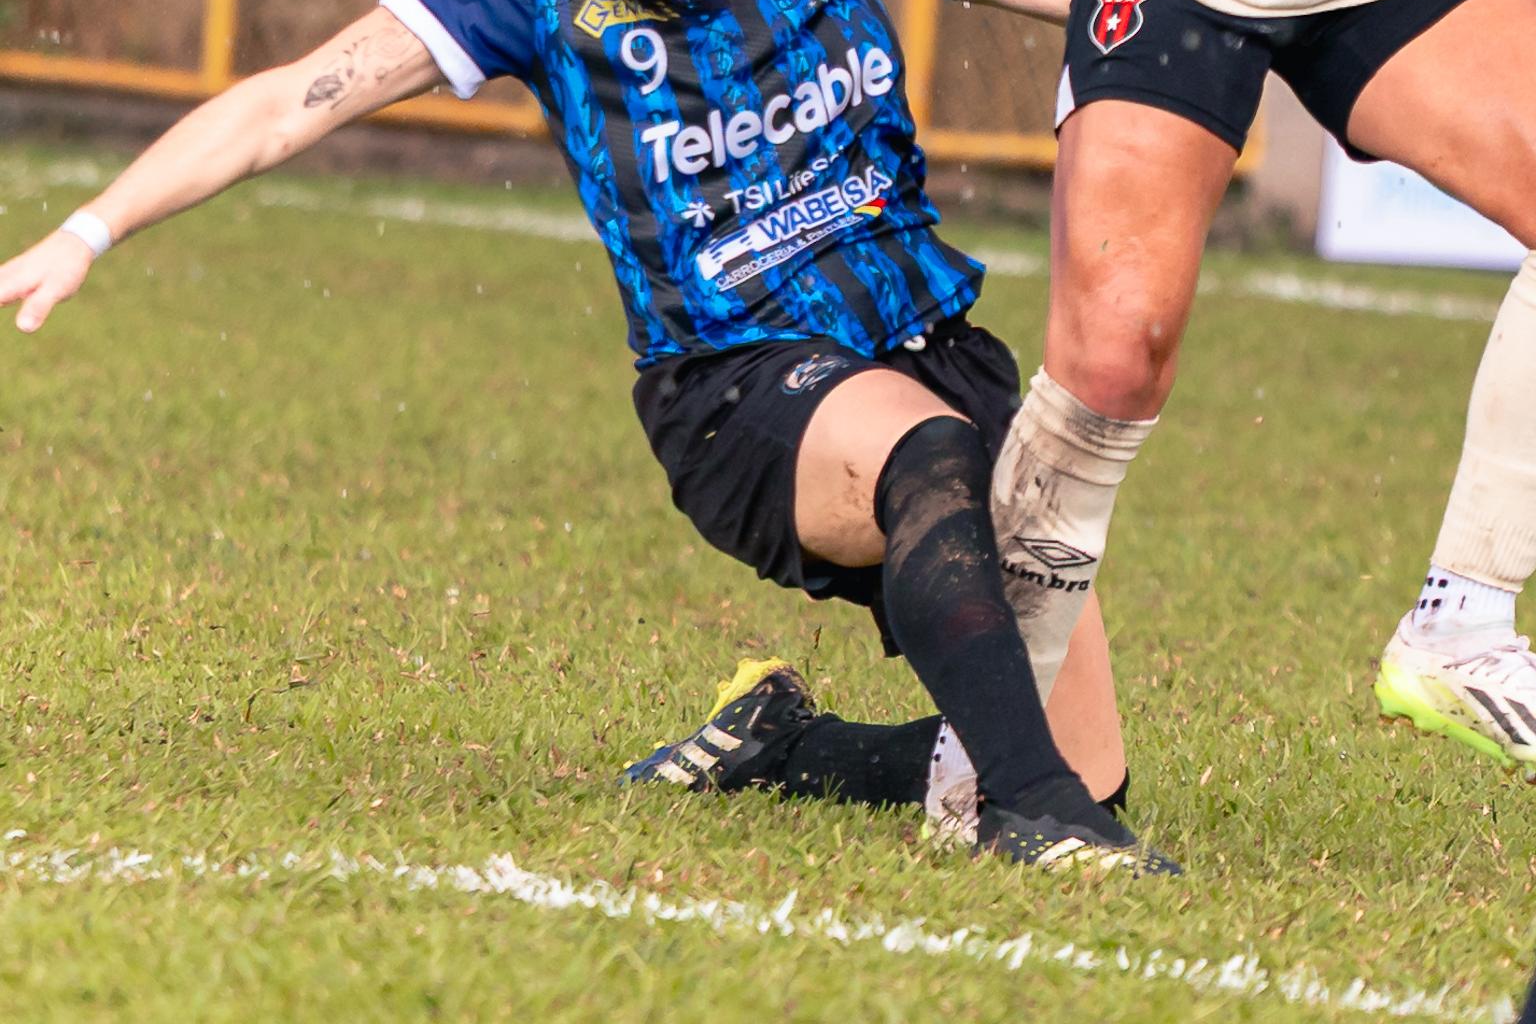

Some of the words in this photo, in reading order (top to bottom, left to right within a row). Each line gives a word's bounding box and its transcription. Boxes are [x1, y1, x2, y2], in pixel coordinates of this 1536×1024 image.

[621, 28, 668, 95] 9
[641, 47, 894, 183] Telecable
[1001, 558, 1091, 592] umbro
